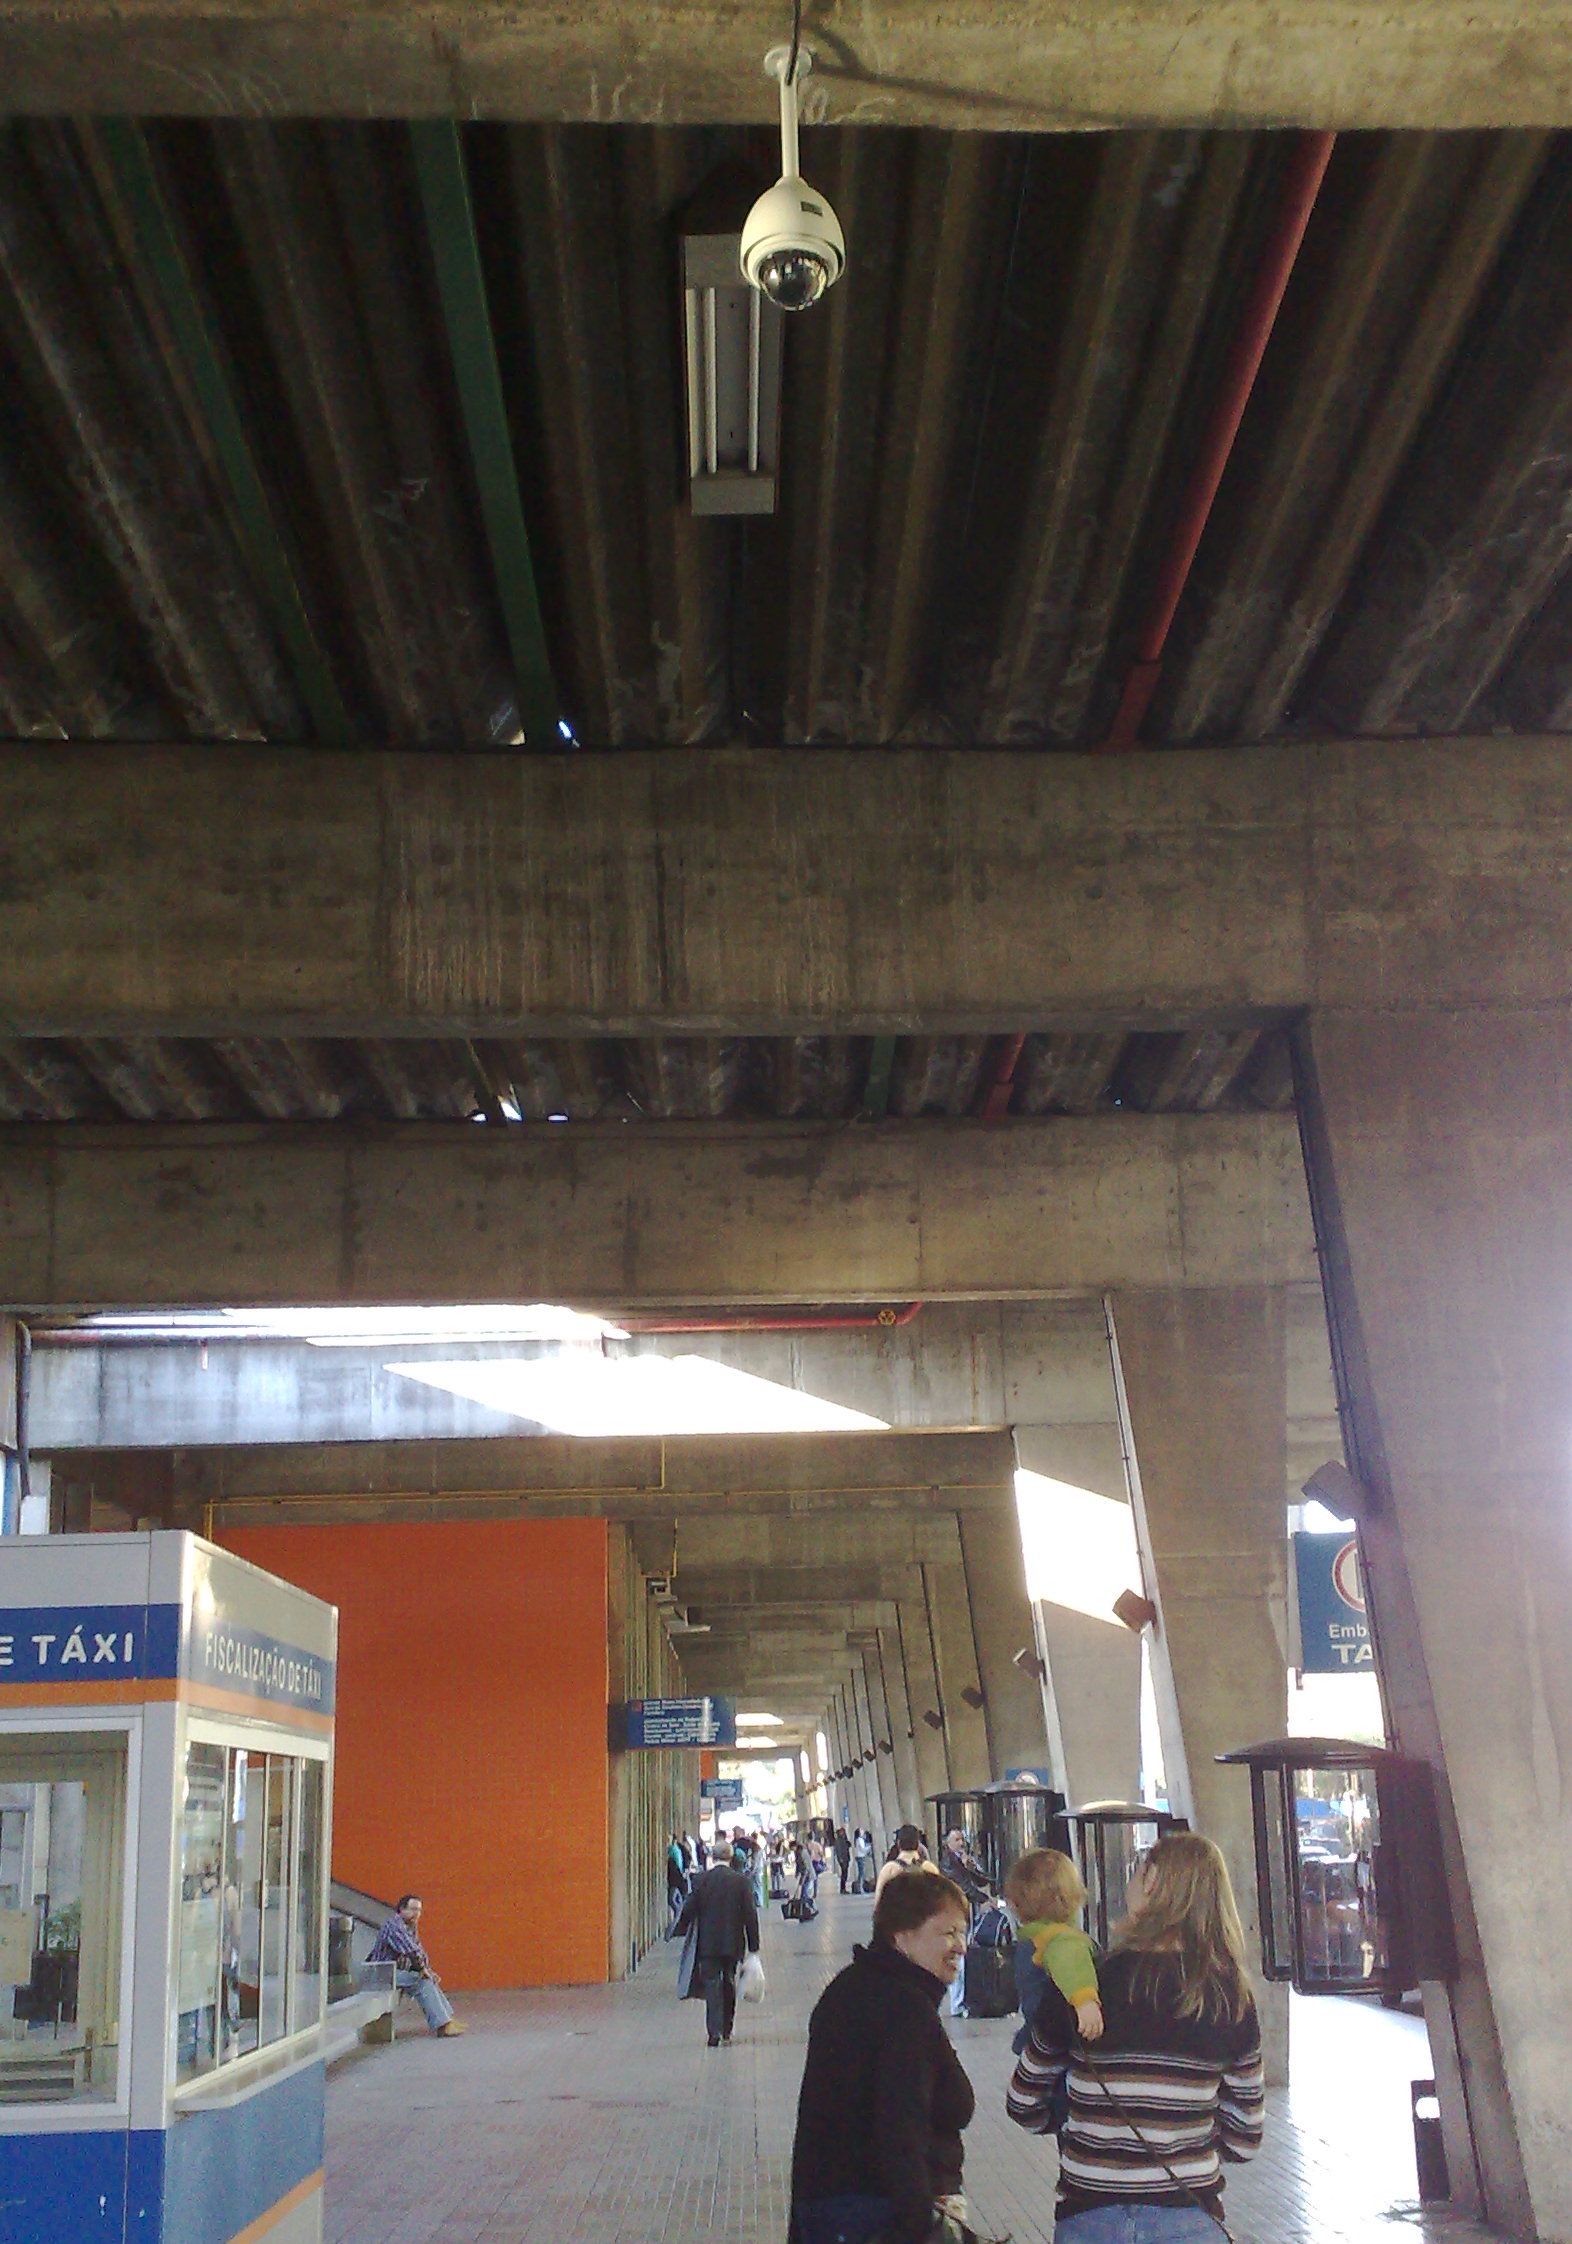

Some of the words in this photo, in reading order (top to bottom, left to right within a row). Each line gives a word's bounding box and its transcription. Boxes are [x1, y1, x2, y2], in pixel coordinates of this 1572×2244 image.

[31, 1624, 134, 1665] TÁXI
[1329, 1624, 1369, 1639] Emb
[205, 1631, 287, 1695] FISCALIZAÇÃO
[288, 1661, 301, 1693] DE
[302, 1658, 321, 1700] TÁXI
